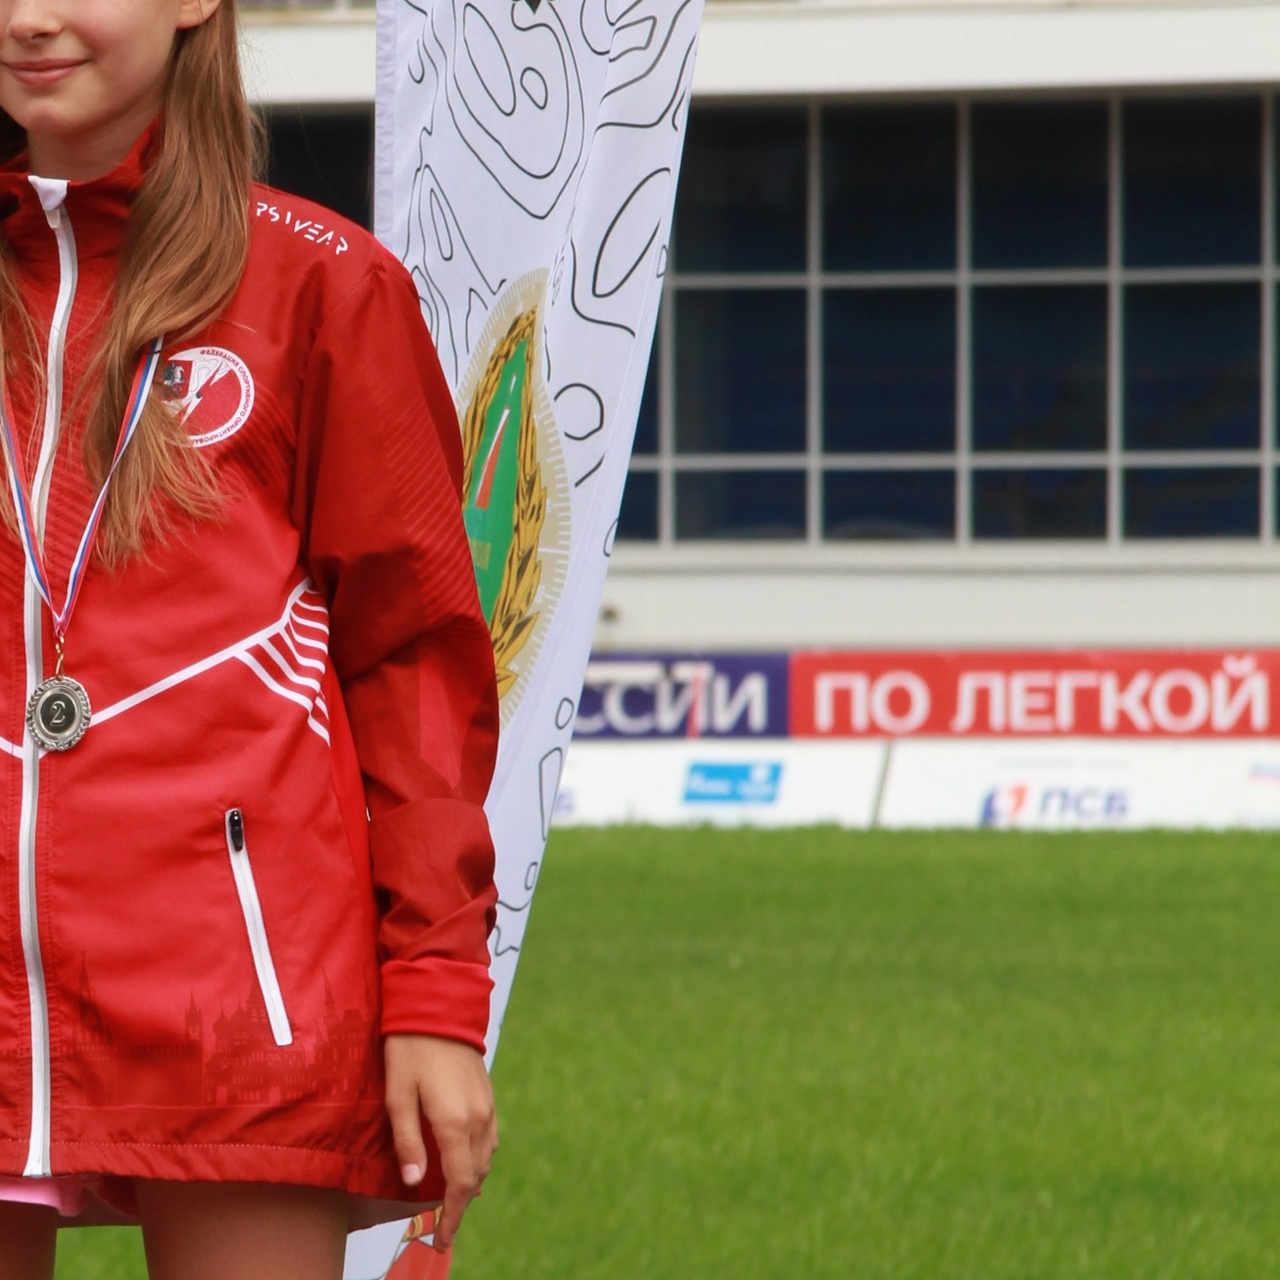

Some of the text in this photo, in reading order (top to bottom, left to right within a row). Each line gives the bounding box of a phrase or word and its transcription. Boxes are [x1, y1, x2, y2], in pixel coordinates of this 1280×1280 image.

[50, 700, 66, 727] 2
[814, 670, 931, 733] ПО
[950, 655, 1269, 733] ЛЕГКОЙ
